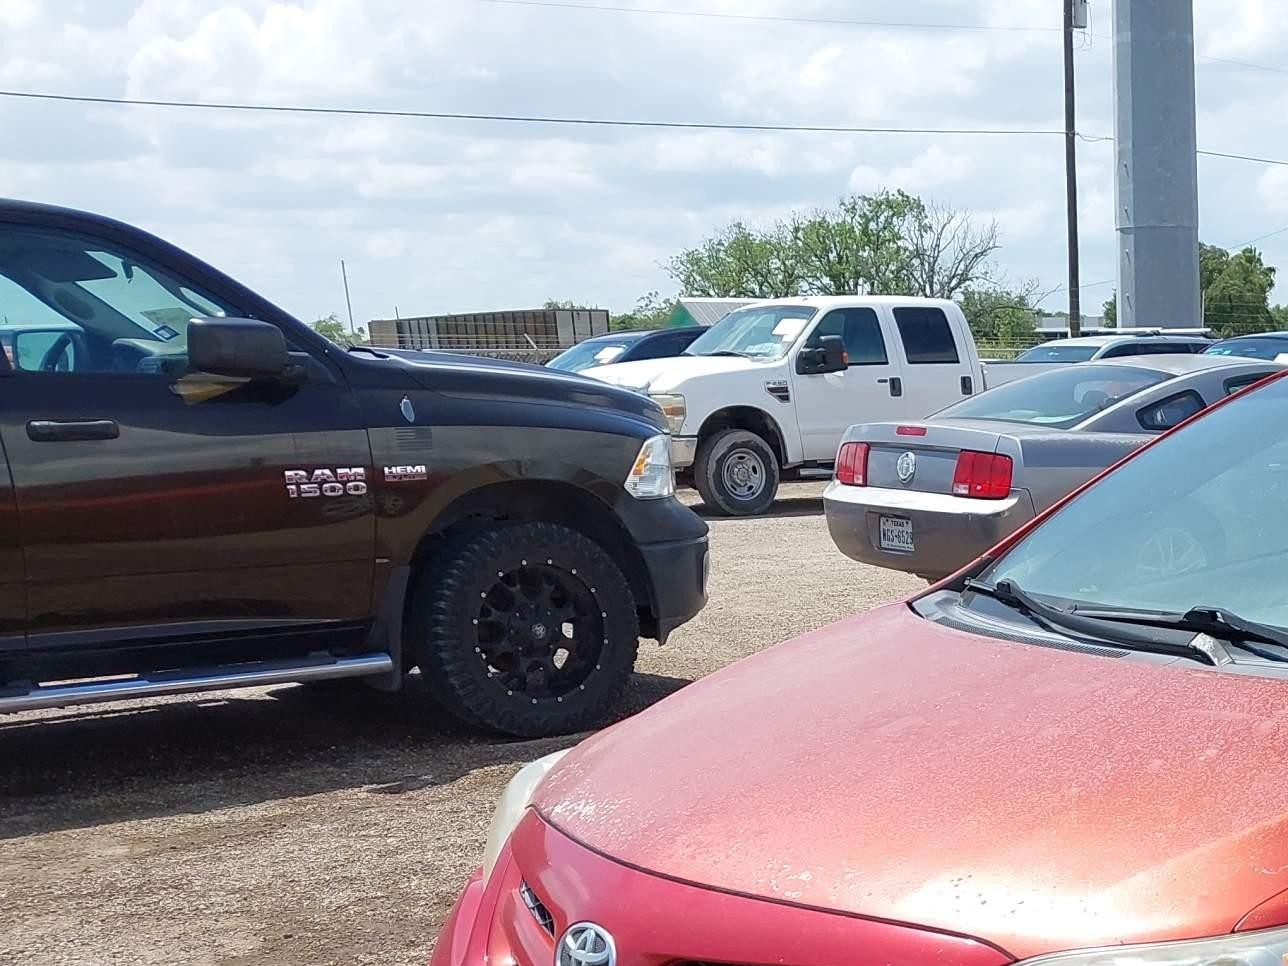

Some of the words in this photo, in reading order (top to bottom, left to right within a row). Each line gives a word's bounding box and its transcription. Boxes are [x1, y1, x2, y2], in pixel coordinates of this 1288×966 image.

[284, 467, 366, 483] RAM
[384, 465, 426, 474] HEMI
[286, 481, 367, 498] 1500
